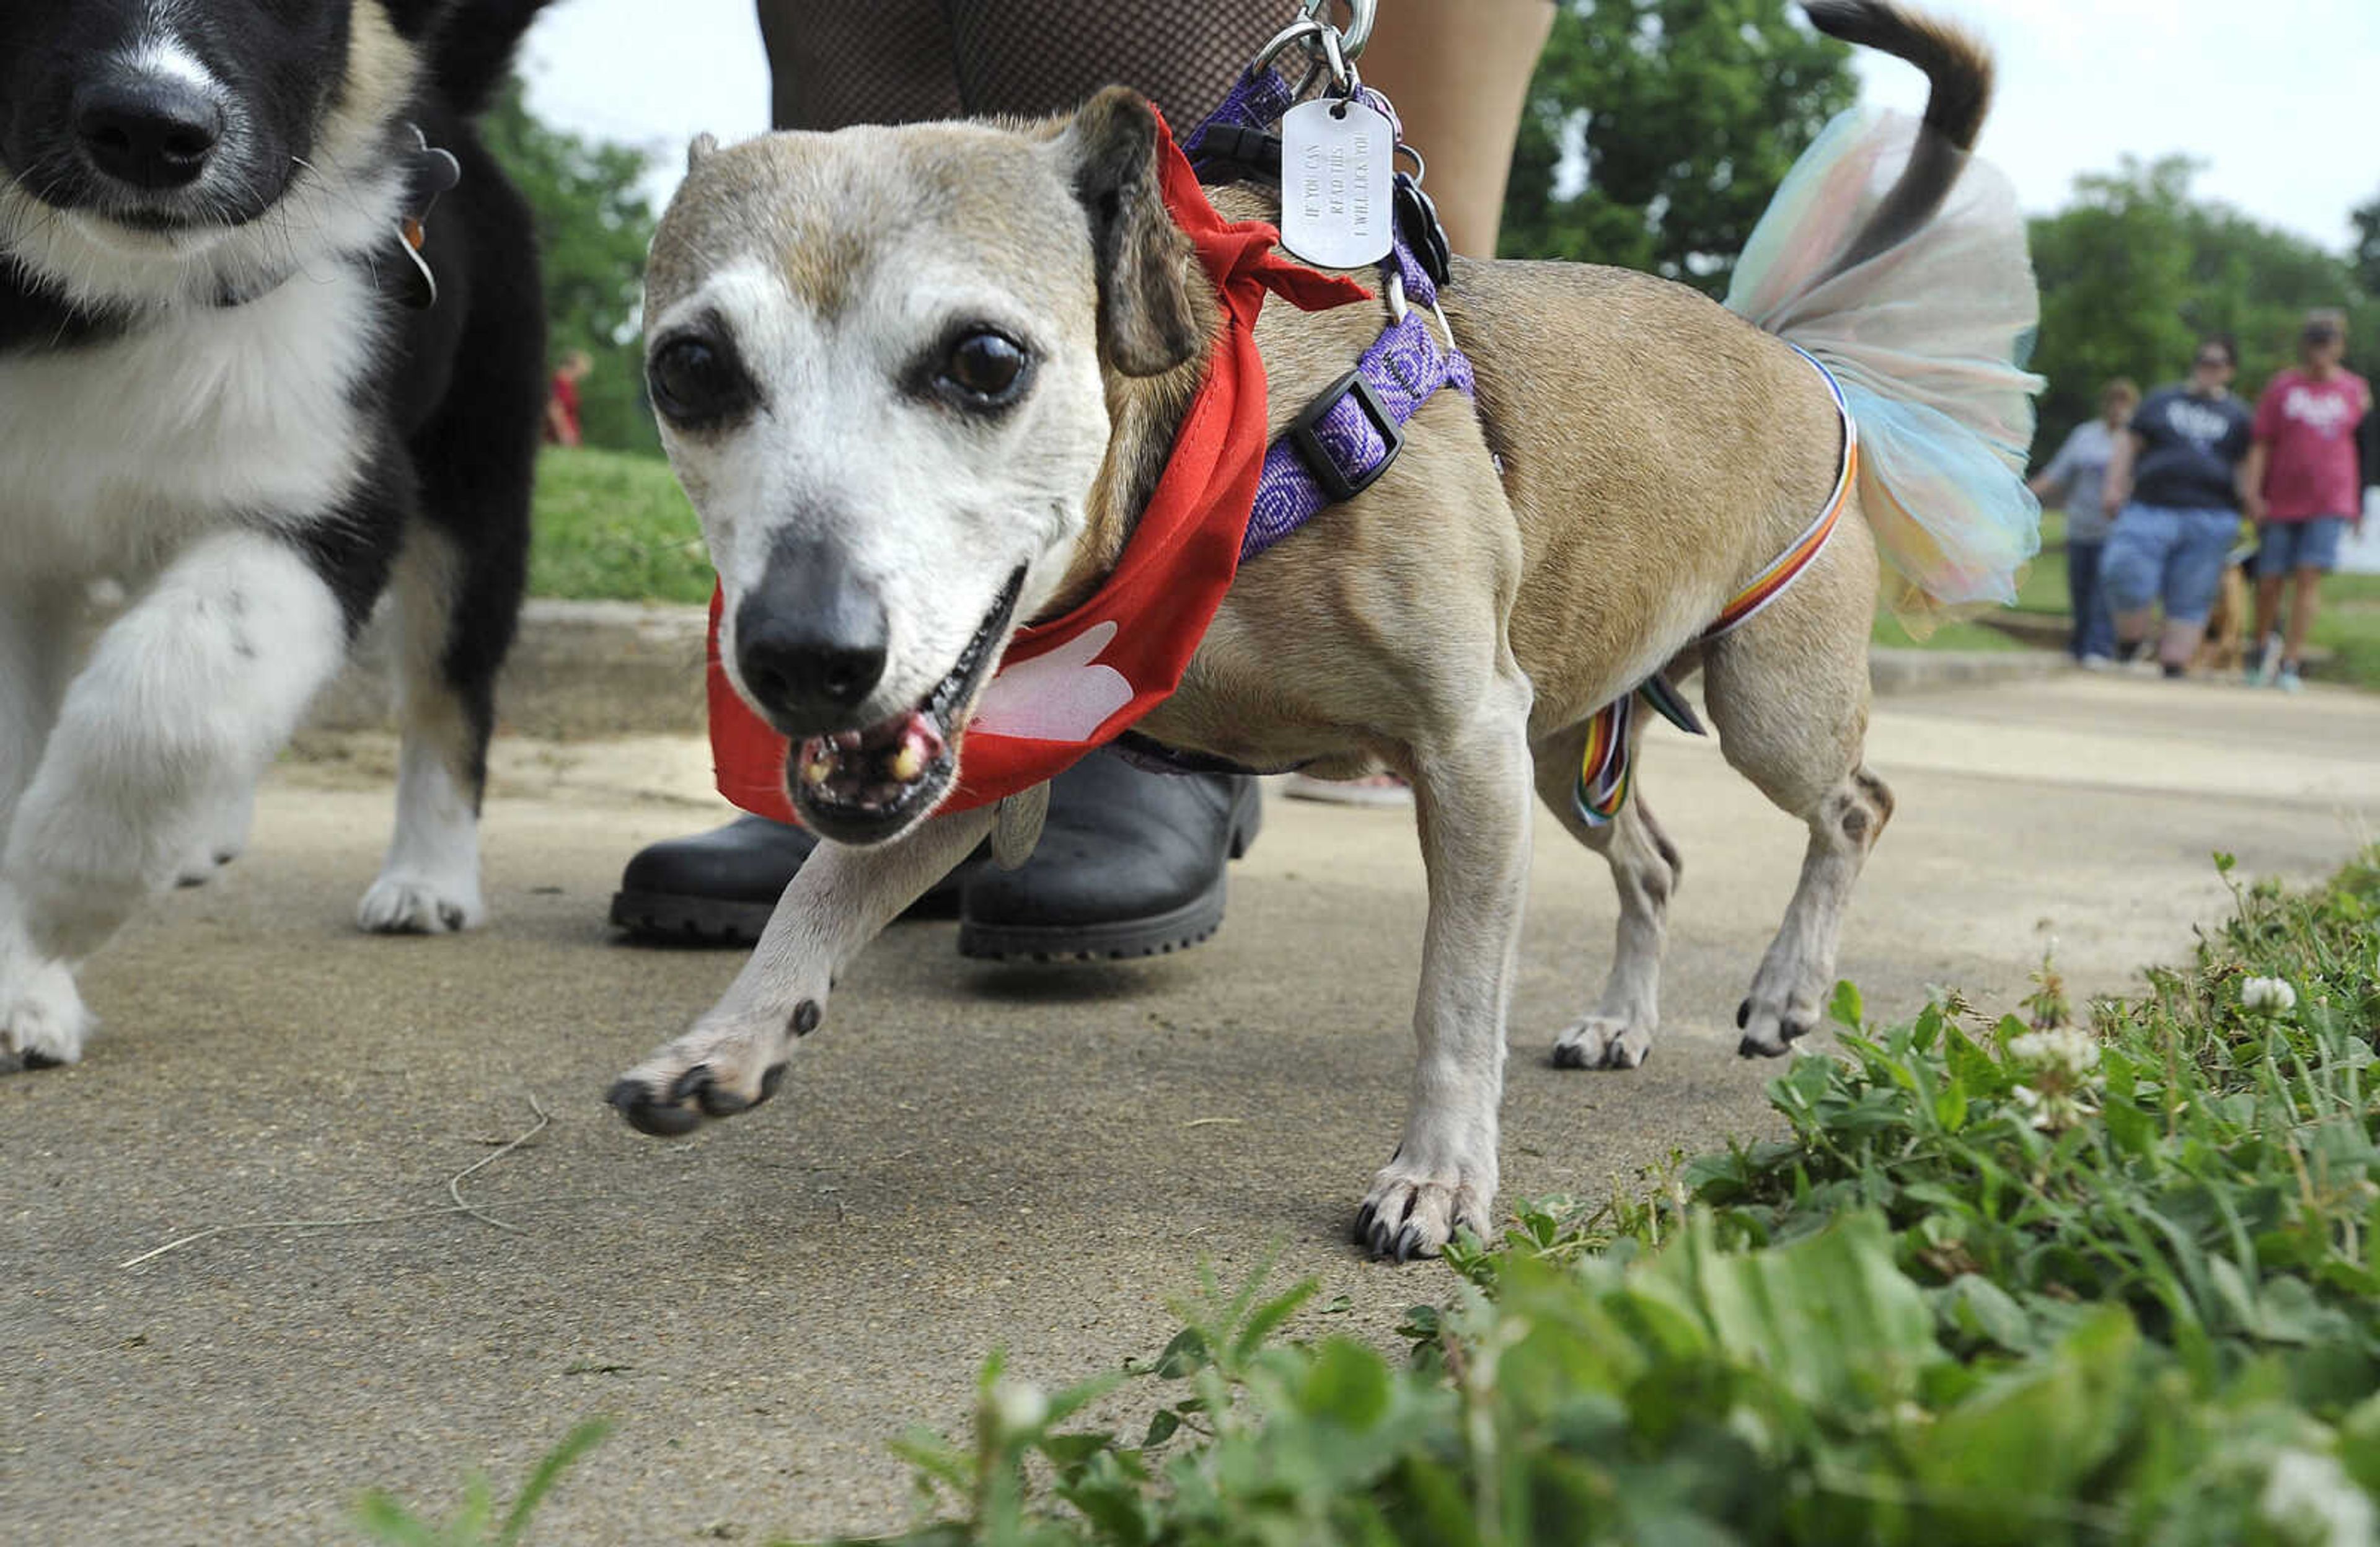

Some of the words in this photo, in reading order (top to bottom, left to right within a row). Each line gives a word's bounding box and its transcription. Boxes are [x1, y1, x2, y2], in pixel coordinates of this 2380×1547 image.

[1354, 131, 1368, 156] YOU
[1305, 144, 1320, 169] CAN
[1329, 148, 1344, 175] THIS
[1304, 175, 1320, 198] YOU
[1354, 164, 1368, 190] LICK
[1330, 180, 1344, 214] READ
[1305, 205, 1320, 217] IF
[1354, 196, 1368, 226] WILL
